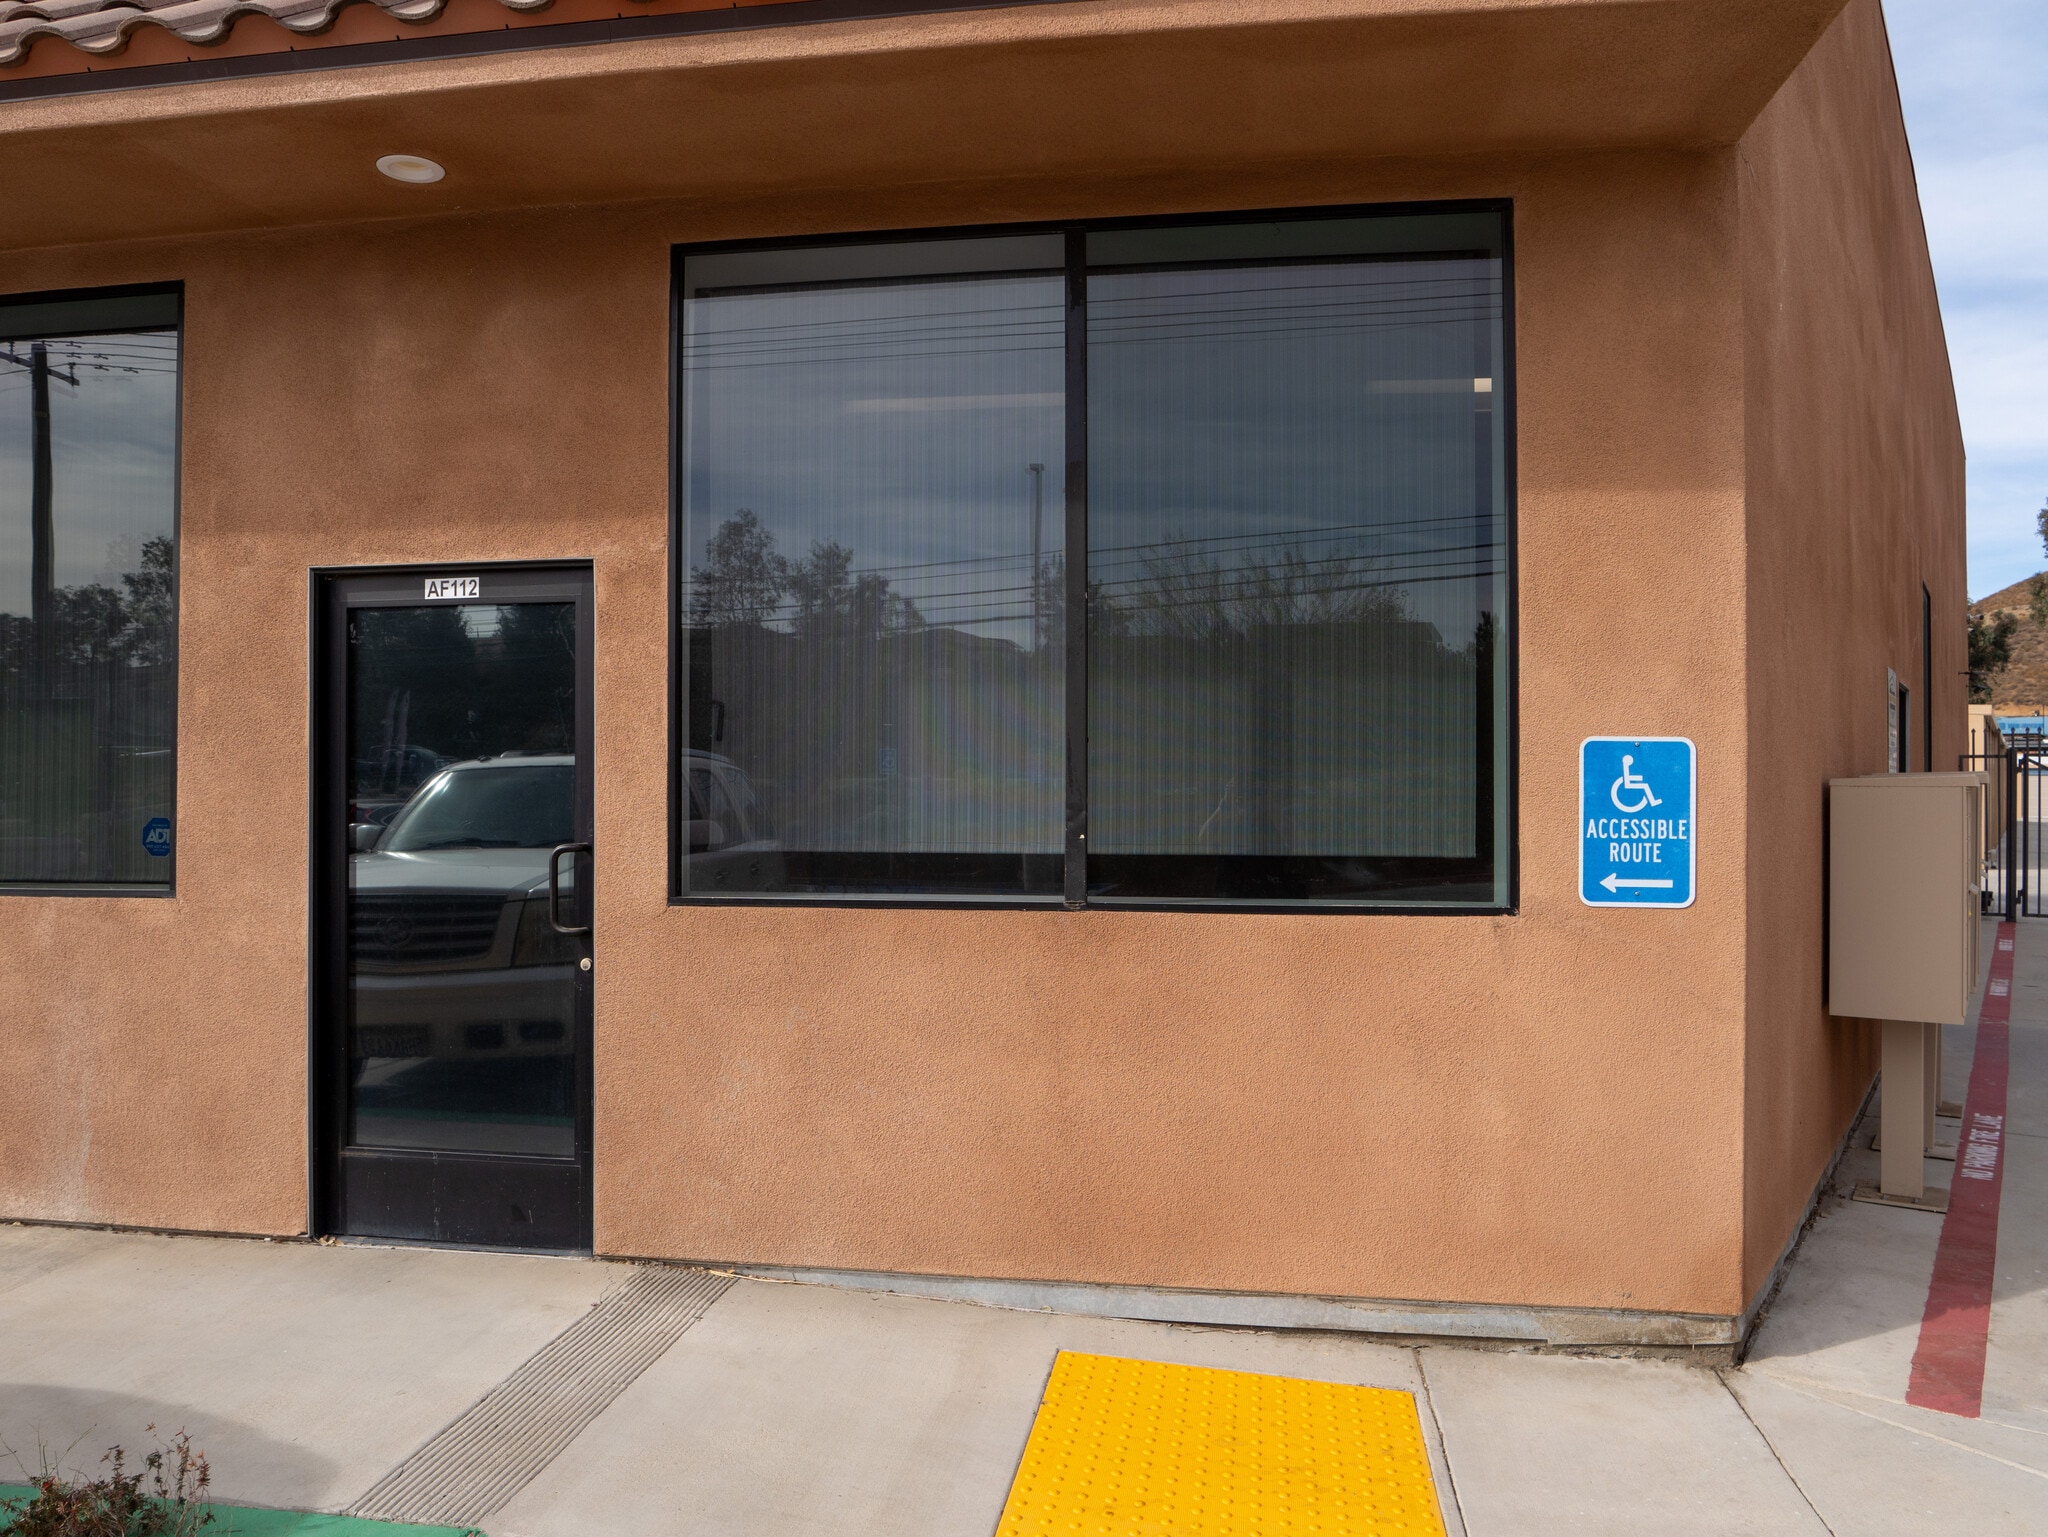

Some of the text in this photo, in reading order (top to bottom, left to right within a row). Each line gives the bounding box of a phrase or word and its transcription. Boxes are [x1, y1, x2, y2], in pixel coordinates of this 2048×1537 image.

[428, 579, 477, 597] AF112
[145, 828, 170, 843] ADT
[1586, 819, 1687, 839] ACCESSIBLE
[1609, 842, 1662, 863] ROUTE
